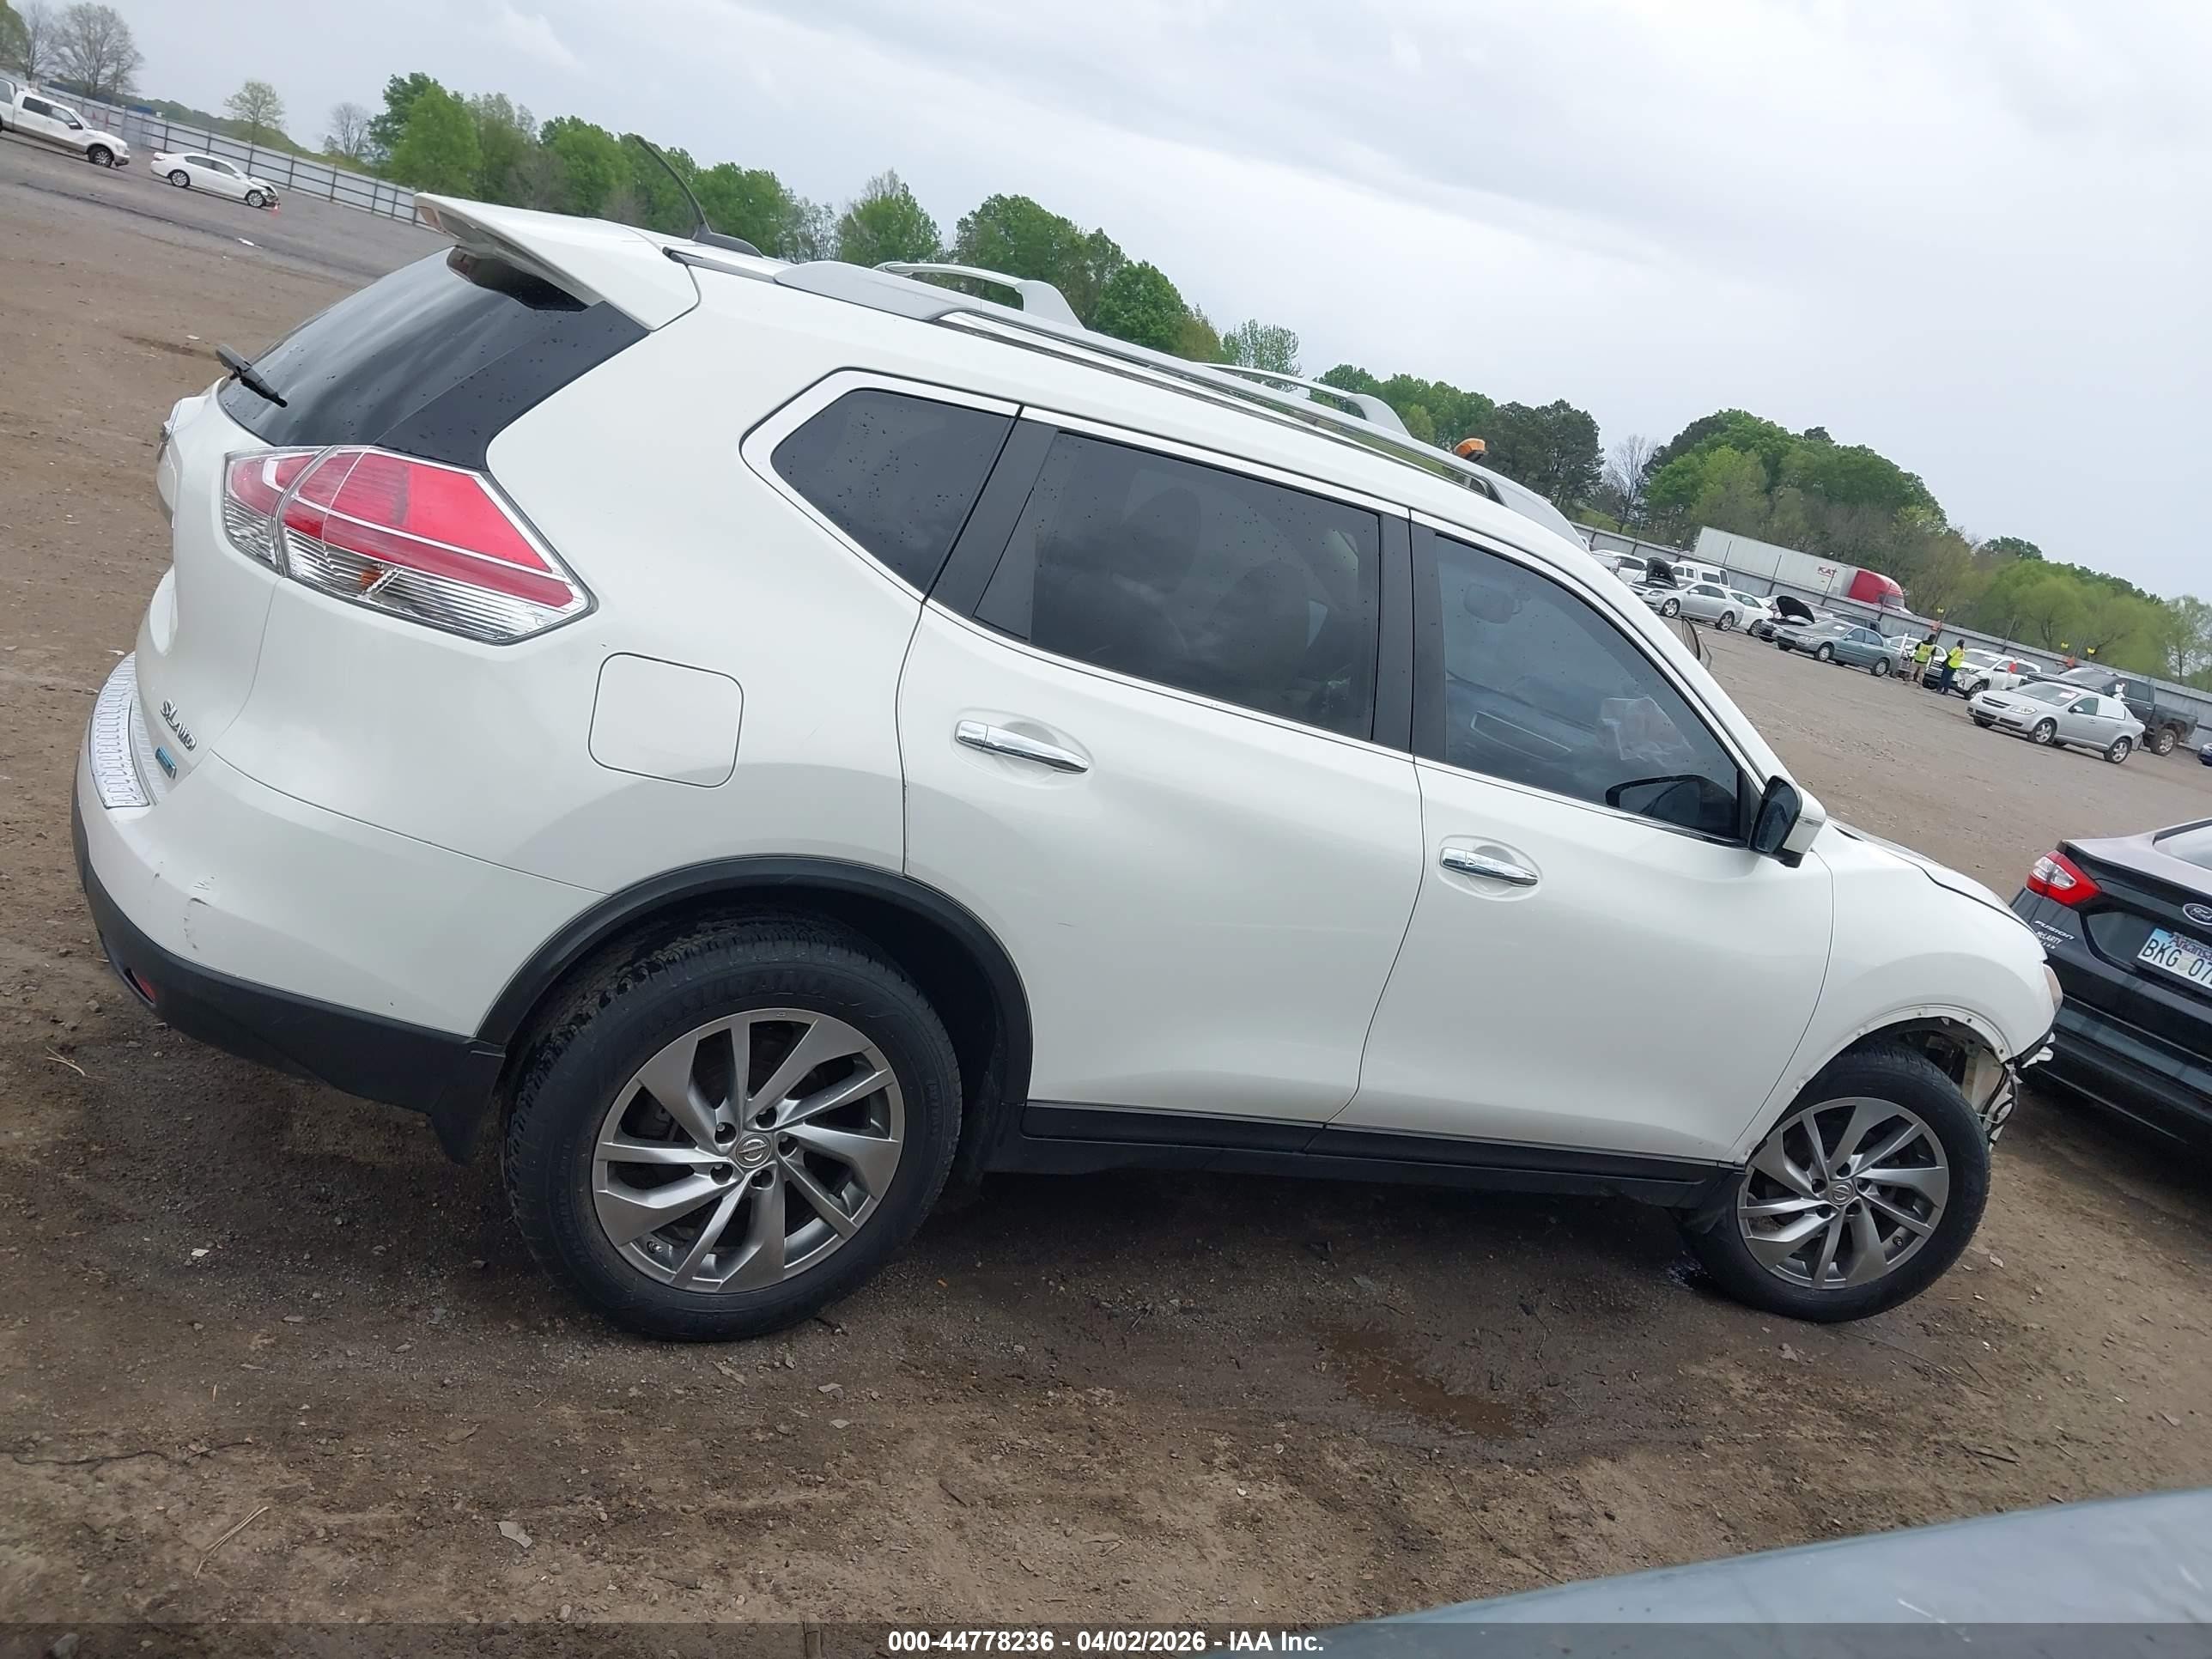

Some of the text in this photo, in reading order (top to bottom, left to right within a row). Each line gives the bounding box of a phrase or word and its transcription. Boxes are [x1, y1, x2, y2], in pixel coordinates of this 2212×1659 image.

[160, 699, 178, 727] SL
[2142, 939, 2212, 986] BKG 07
